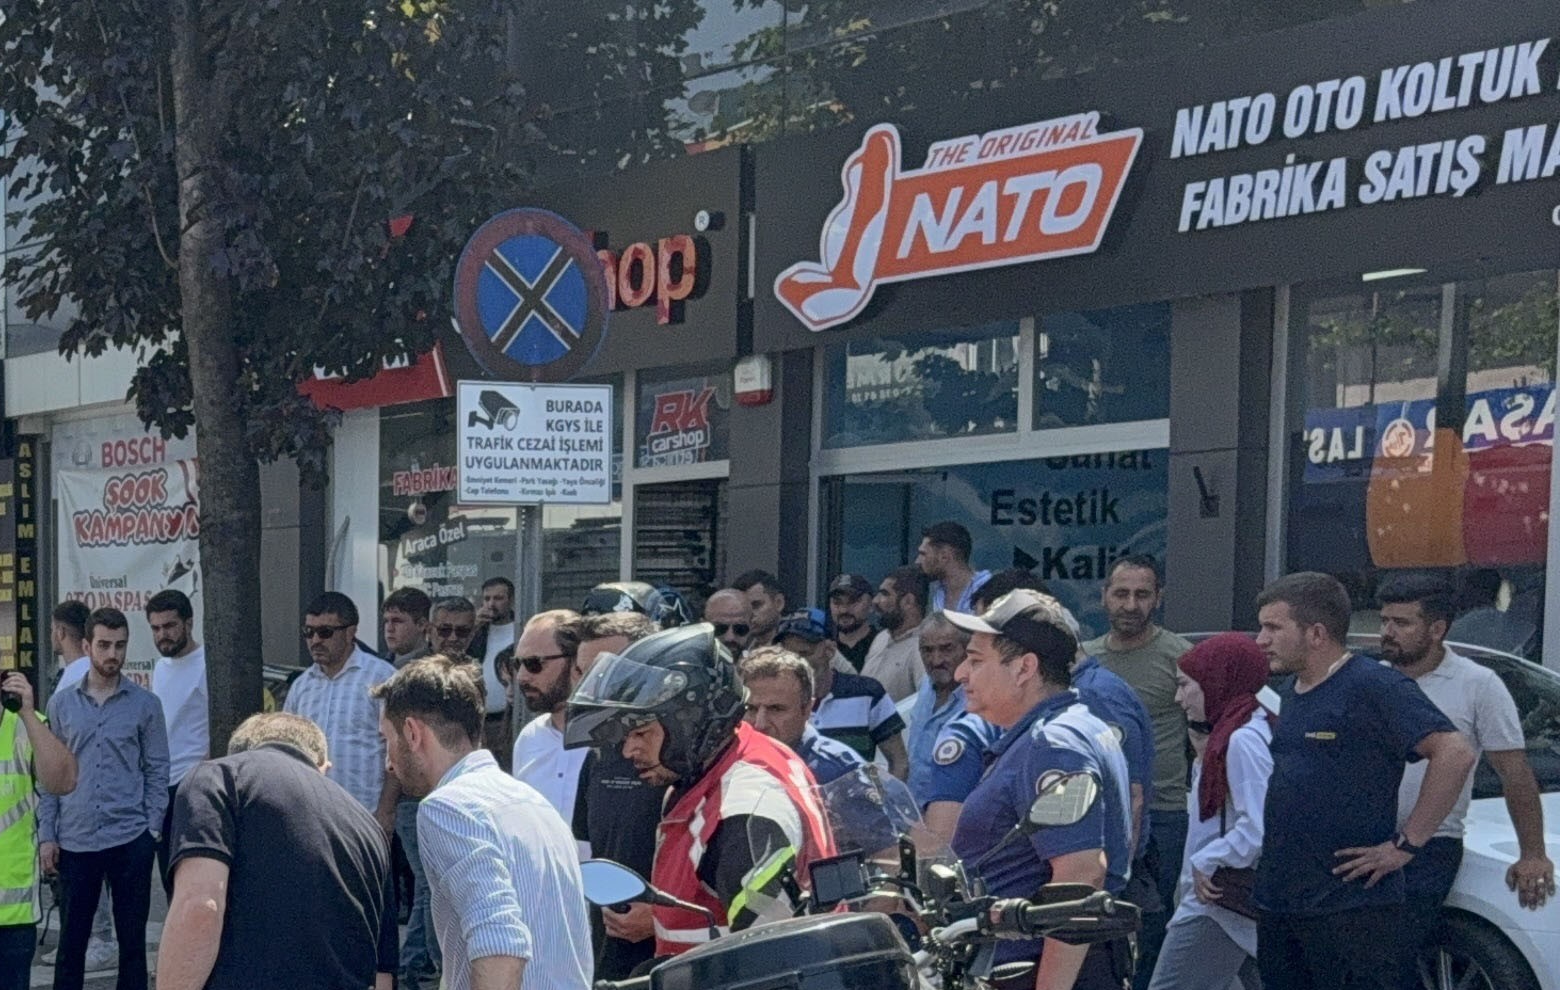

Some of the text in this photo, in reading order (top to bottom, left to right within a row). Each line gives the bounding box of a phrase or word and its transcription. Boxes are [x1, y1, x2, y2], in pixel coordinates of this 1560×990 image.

[1170, 37, 1552, 159] NATO OTO KOLTUK
[928, 118, 1094, 169] THE ORIGINAL
[1177, 153, 1347, 233] FABRİKA
[1358, 134, 1487, 204] SATIŞ
[896, 162, 1103, 260] NATO
[546, 400, 603, 413] BURADA
[652, 386, 718, 434] RK
[546, 417, 603, 433] KGYS İLE
[652, 429, 705, 453] carshop
[101, 436, 166, 468] BOSCH
[467, 435, 604, 454] TRAFİK CEZAİ İŞLEMİ
[465, 456, 604, 471] UYGULANMAKTADIR
[990, 487, 1122, 526] Estetik
[405, 522, 466, 555] Araca Özel
